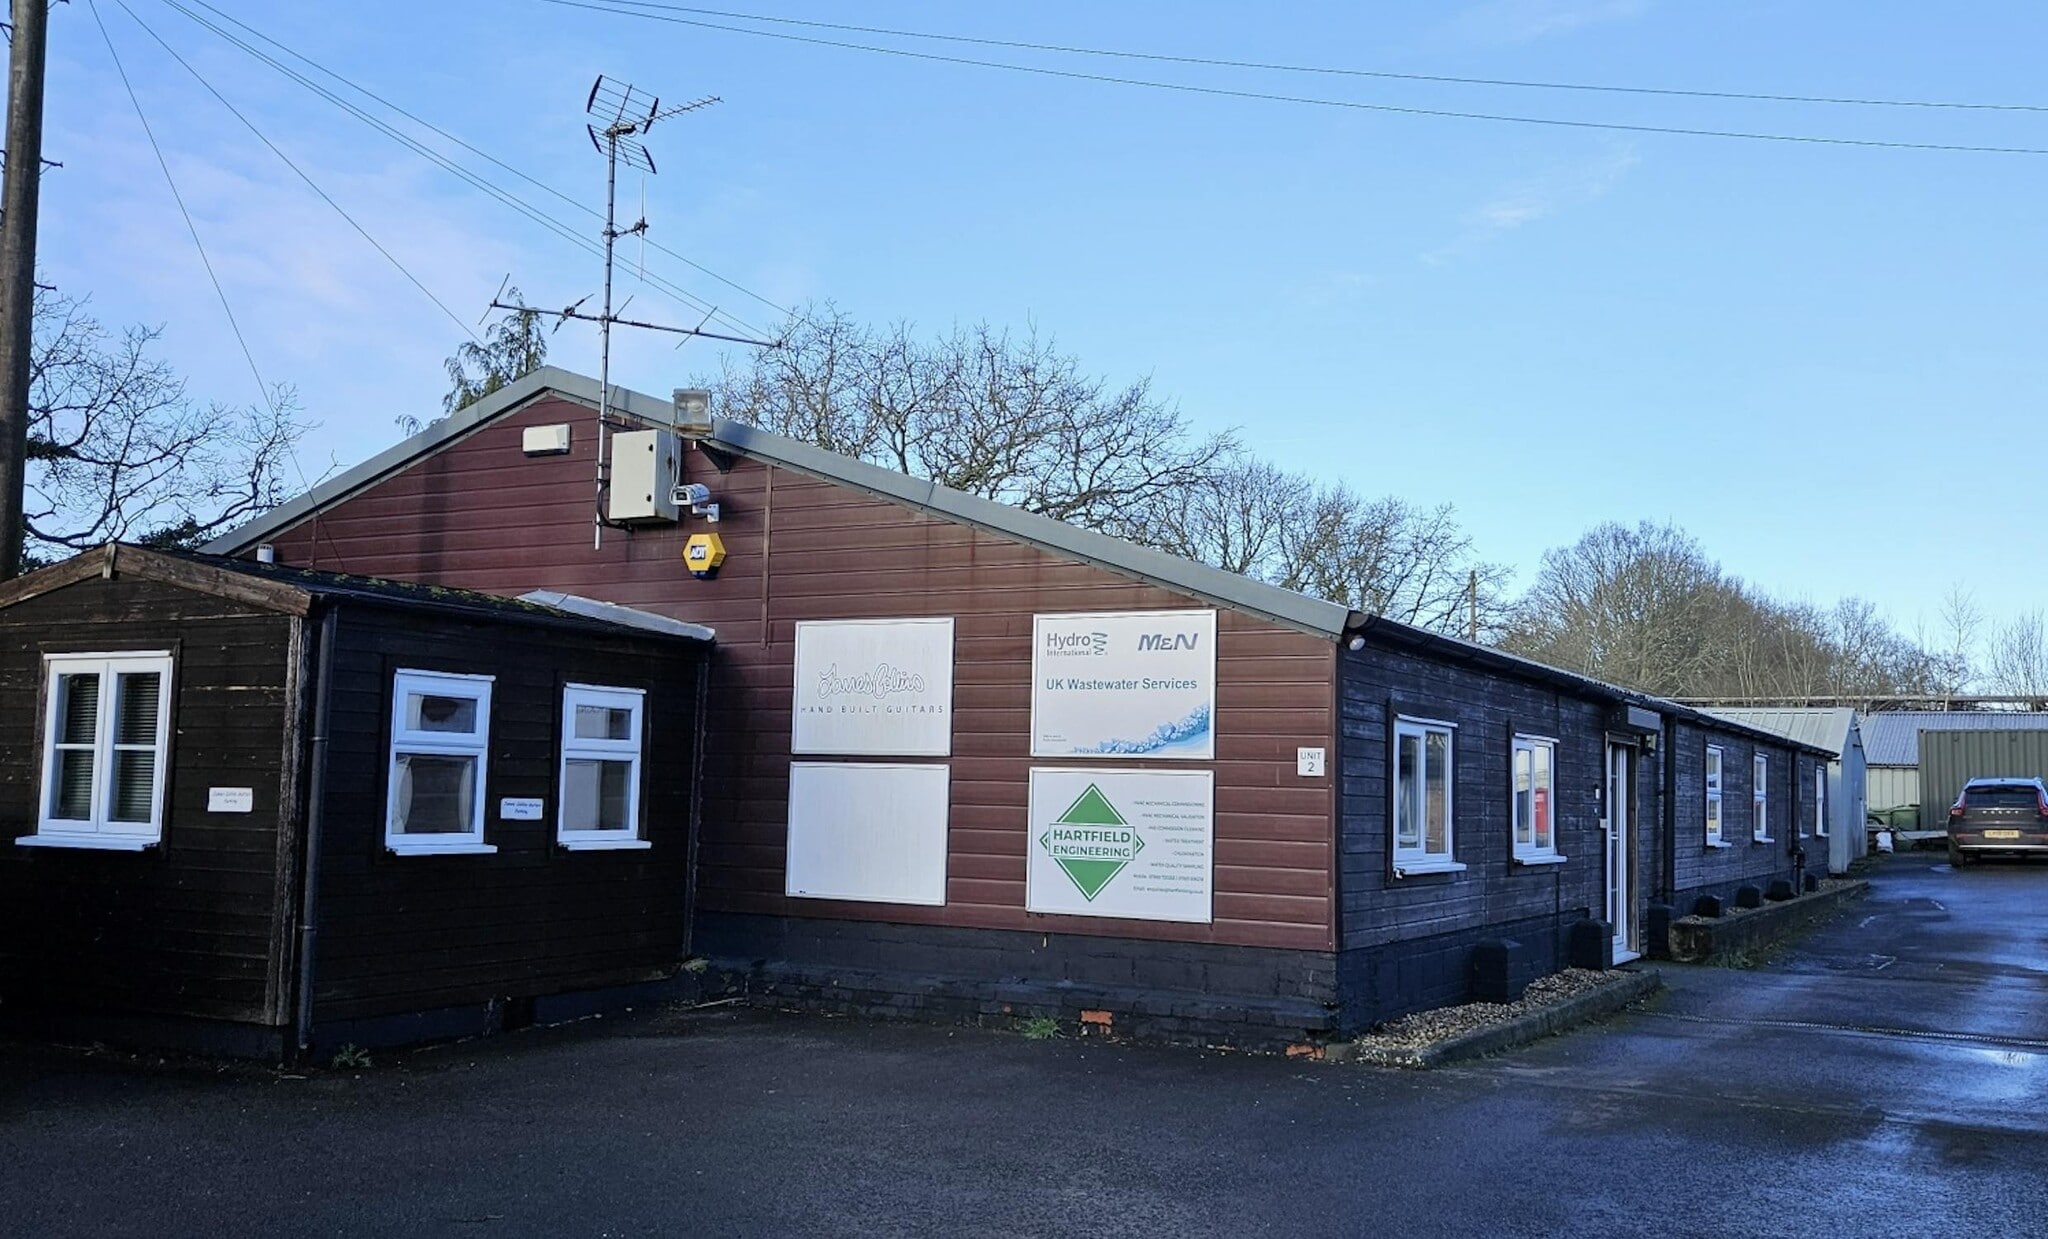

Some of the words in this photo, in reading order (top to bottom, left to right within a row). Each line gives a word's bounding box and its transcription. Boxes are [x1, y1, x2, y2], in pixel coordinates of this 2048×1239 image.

[690, 546, 706, 559] ADT
[1046, 632, 1091, 650] Hydro
[1046, 649, 1092, 657] International
[1046, 678, 1064, 690] UK
[1067, 678, 1139, 690] Wastewater
[1142, 677, 1198, 690] Services
[800, 705, 833, 714] HAND
[841, 705, 878, 714] BUILT
[886, 705, 944, 714] GUITARS
[1300, 751, 1321, 760] UNIT
[1308, 761, 1315, 772] 2
[1053, 829, 1131, 843] HARTFIELD
[1053, 845, 1131, 857] ENGINEERING
